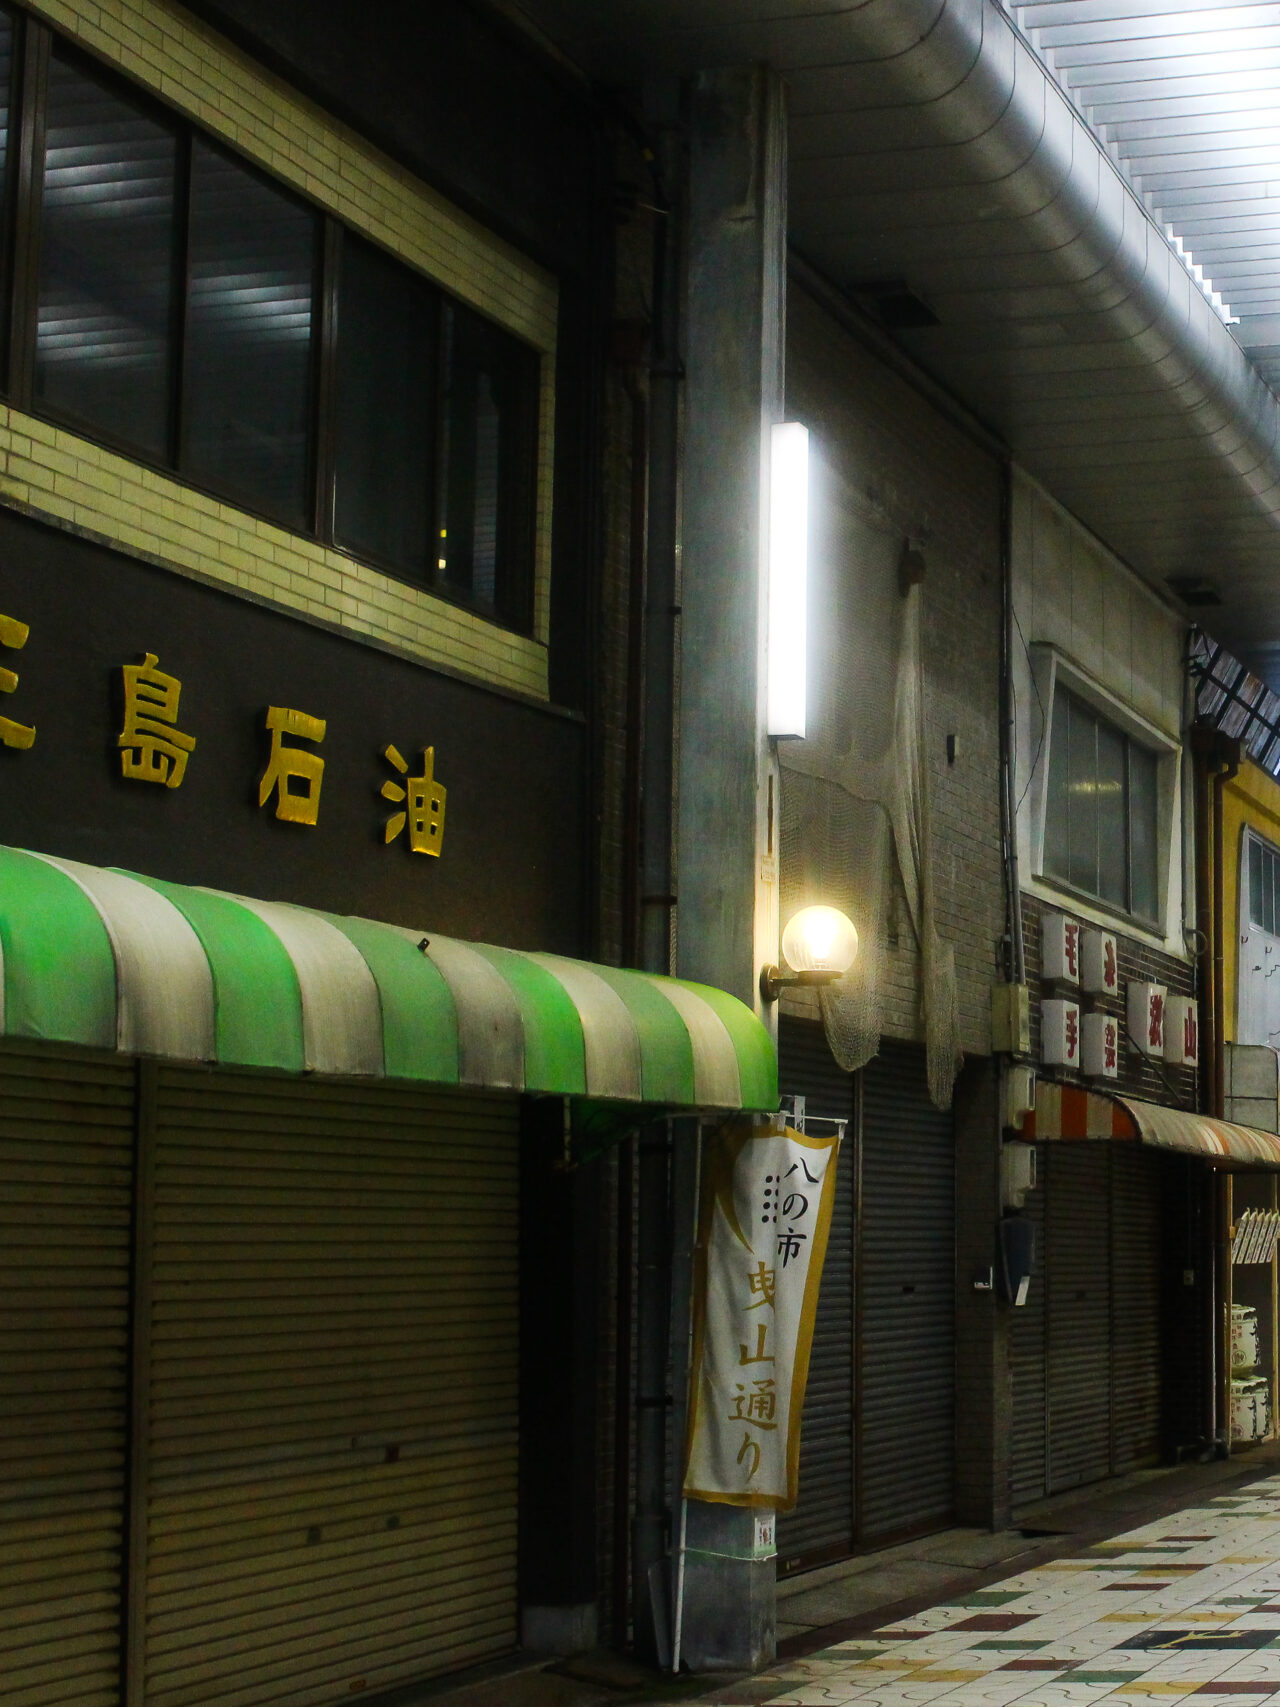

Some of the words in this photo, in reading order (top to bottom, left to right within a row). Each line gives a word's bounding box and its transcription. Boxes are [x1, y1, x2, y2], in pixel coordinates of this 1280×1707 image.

[777, 1156, 820, 1268] 八の市
[727, 1259, 779, 1484] 曳山通り
